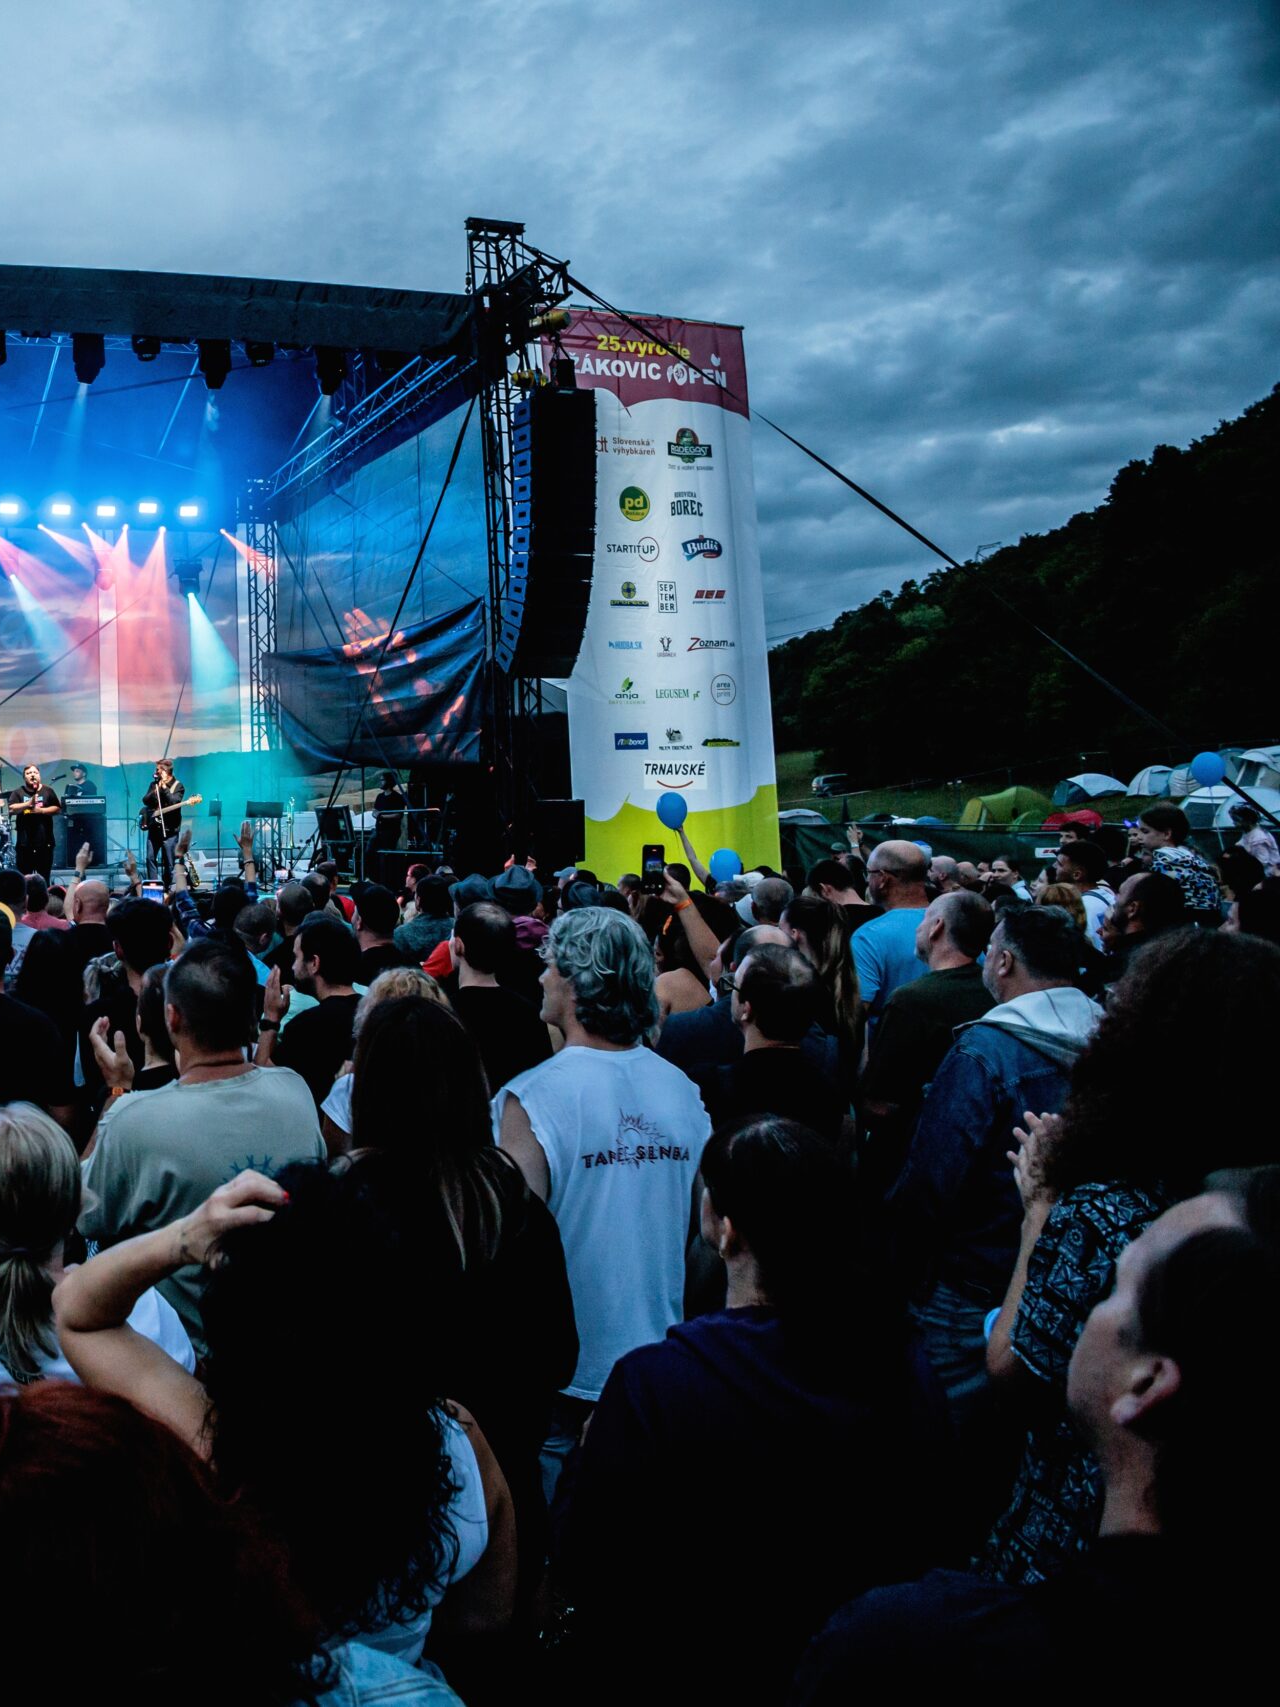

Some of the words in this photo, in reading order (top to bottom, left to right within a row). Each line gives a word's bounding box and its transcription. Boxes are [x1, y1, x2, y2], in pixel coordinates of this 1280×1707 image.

[613, 437, 650, 446] Slovenská
[671, 445, 709, 456] RADEGOST
[671, 500, 703, 516] BOREC
[687, 539, 718, 554] Budiš
[656, 689, 689, 698] LEGUSEM
[645, 762, 705, 775] TRNAVSKÉ
